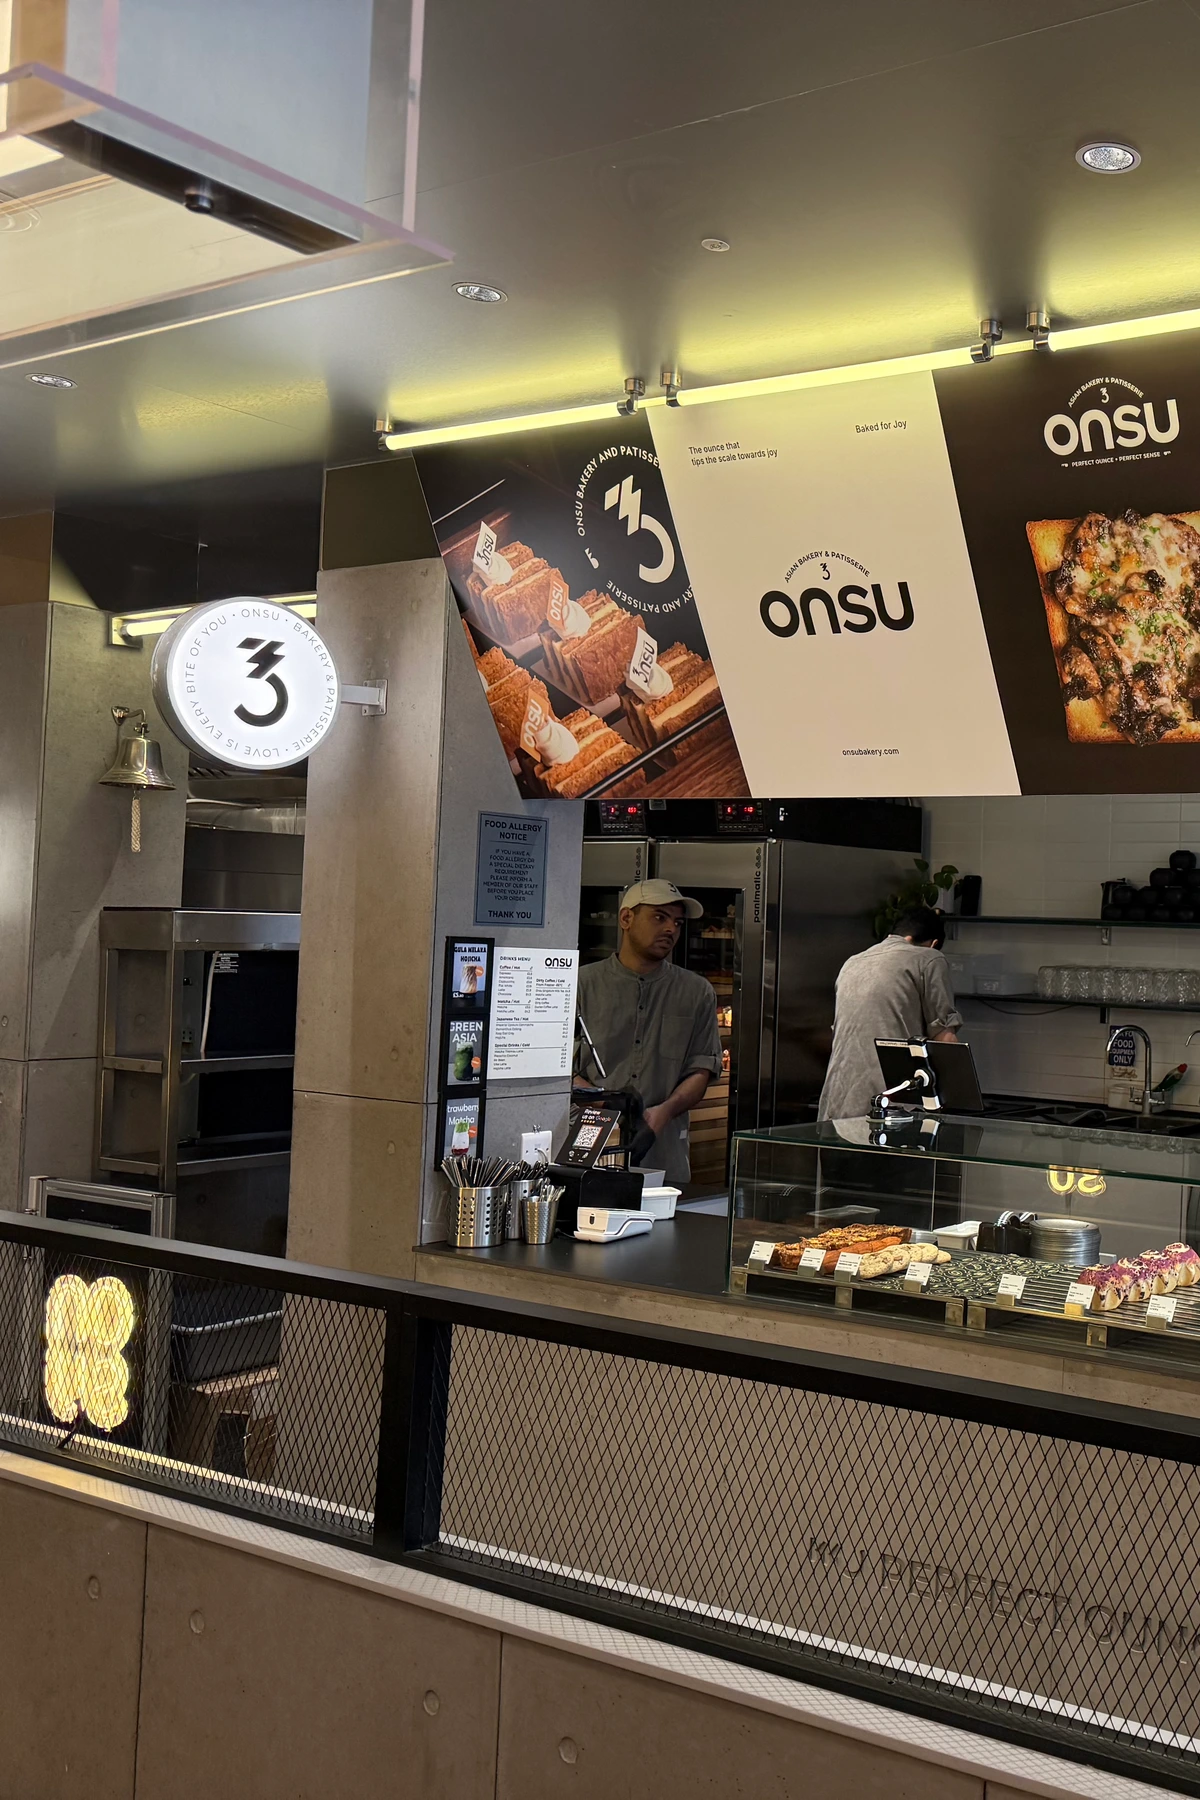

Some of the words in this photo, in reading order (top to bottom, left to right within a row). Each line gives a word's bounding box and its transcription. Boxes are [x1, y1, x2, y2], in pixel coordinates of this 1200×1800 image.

[1068, 389, 1082, 408] ASIAN
[1081, 378, 1104, 392] BAKERY
[1111, 377, 1144, 398] PATISSERIE
[856, 422, 879, 434] Baked
[880, 421, 891, 430] for
[894, 420, 907, 430] Joy
[598, 446, 618, 463] AND
[689, 446, 702, 455] The
[704, 444, 724, 453] ounce
[726, 442, 740, 450] that
[620, 445, 661, 469] PATISSE
[692, 457, 704, 466] tips
[706, 455, 717, 464] the
[718, 452, 736, 462] scale
[738, 450, 766, 460] towards
[766, 448, 778, 458] joy
[1072, 460, 1094, 468] PERFECT
[1118, 454, 1142, 462] PERFECT
[576, 458, 598, 499] BAKERY
[575, 501, 586, 536] ONSU
[784, 562, 798, 583] ASIAN
[798, 551, 823, 566] BAKERY
[831, 552, 870, 577] PATISSERIE
[241, 608, 280, 621] ONSU
[202, 616, 227, 636] YOU
[190, 638, 202, 657] OF
[293, 622, 332, 669] BAKERY
[185, 662, 196, 694] BITE
[190, 700, 222, 740] EVERY
[293, 688, 336, 752] PATISSERIE
[226, 738, 238, 750] IS
[244, 746, 280, 757] LOVE
[842, 748, 900, 756] onsubakery.com
[485, 820, 506, 829] FOOD
[508, 822, 542, 832] ALLERGY
[500, 832, 527, 841] NOTICE
[488, 910, 514, 918] THANK
[450, 1022, 483, 1032] GREEN
[452, 1032, 478, 1042] ASIA
[1113, 1040, 1134, 1048] FOOD
[1114, 1055, 1132, 1064] ONLY
[448, 1116, 474, 1125] Matcha
[880, 1554, 1072, 1632] PERFECT
